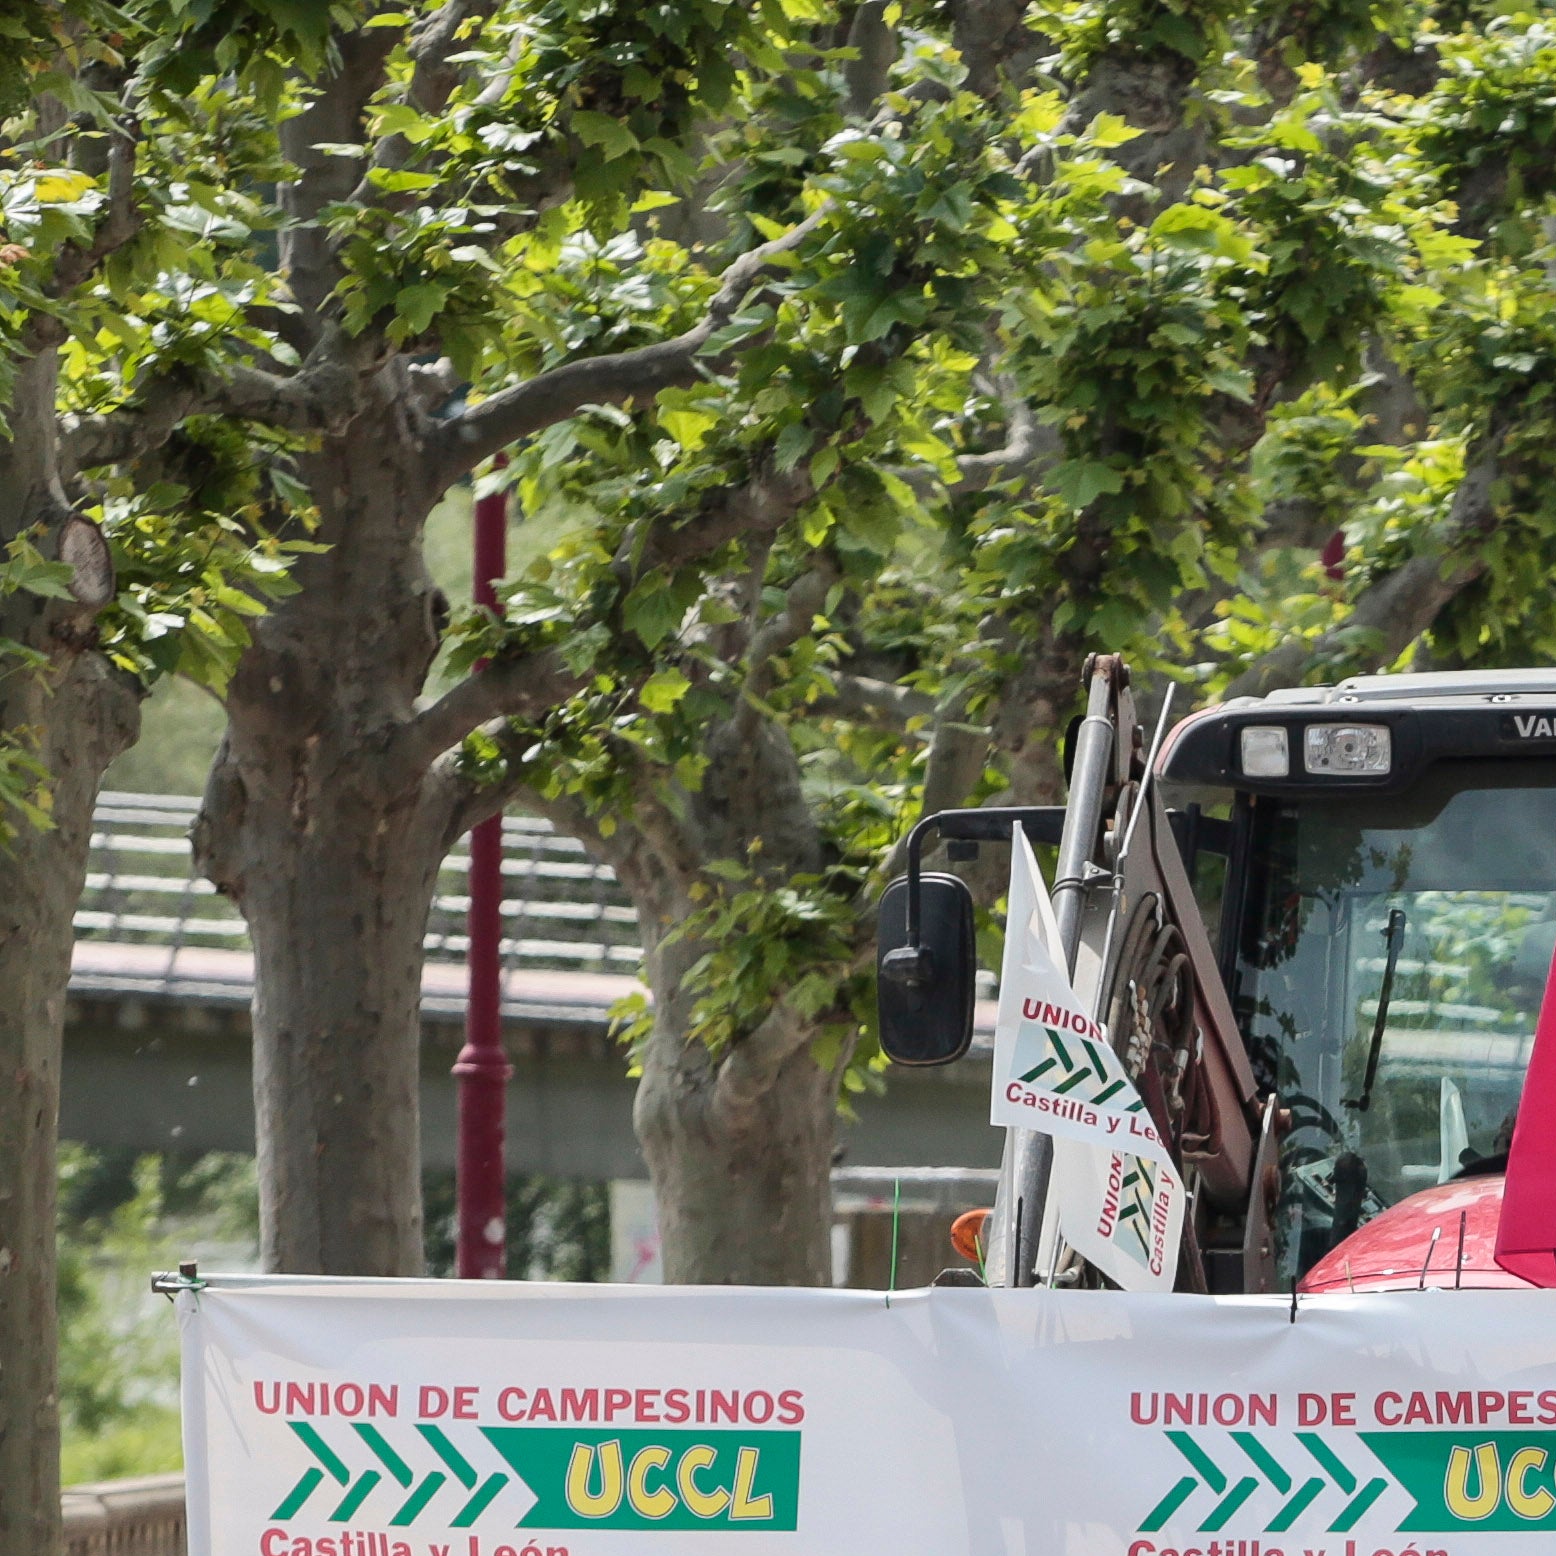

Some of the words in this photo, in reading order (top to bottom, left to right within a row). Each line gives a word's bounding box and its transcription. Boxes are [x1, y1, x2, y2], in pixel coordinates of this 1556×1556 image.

[1022, 997, 1105, 1043] UNION
[1005, 1081, 1099, 1127] Castilla
[1106, 1115, 1122, 1134] y
[1129, 1116, 1166, 1150] Le
[1096, 1153, 1124, 1240] UNION
[1149, 1194, 1171, 1277] Castilla
[1160, 1170, 1176, 1190] y
[256, 1381, 398, 1417] UNION
[419, 1386, 479, 1419] DE
[498, 1387, 806, 1425] CAMPESINOS
[1131, 1393, 1278, 1426] UNION
[1298, 1392, 1356, 1426] DE
[566, 1440, 775, 1521] UCCL
